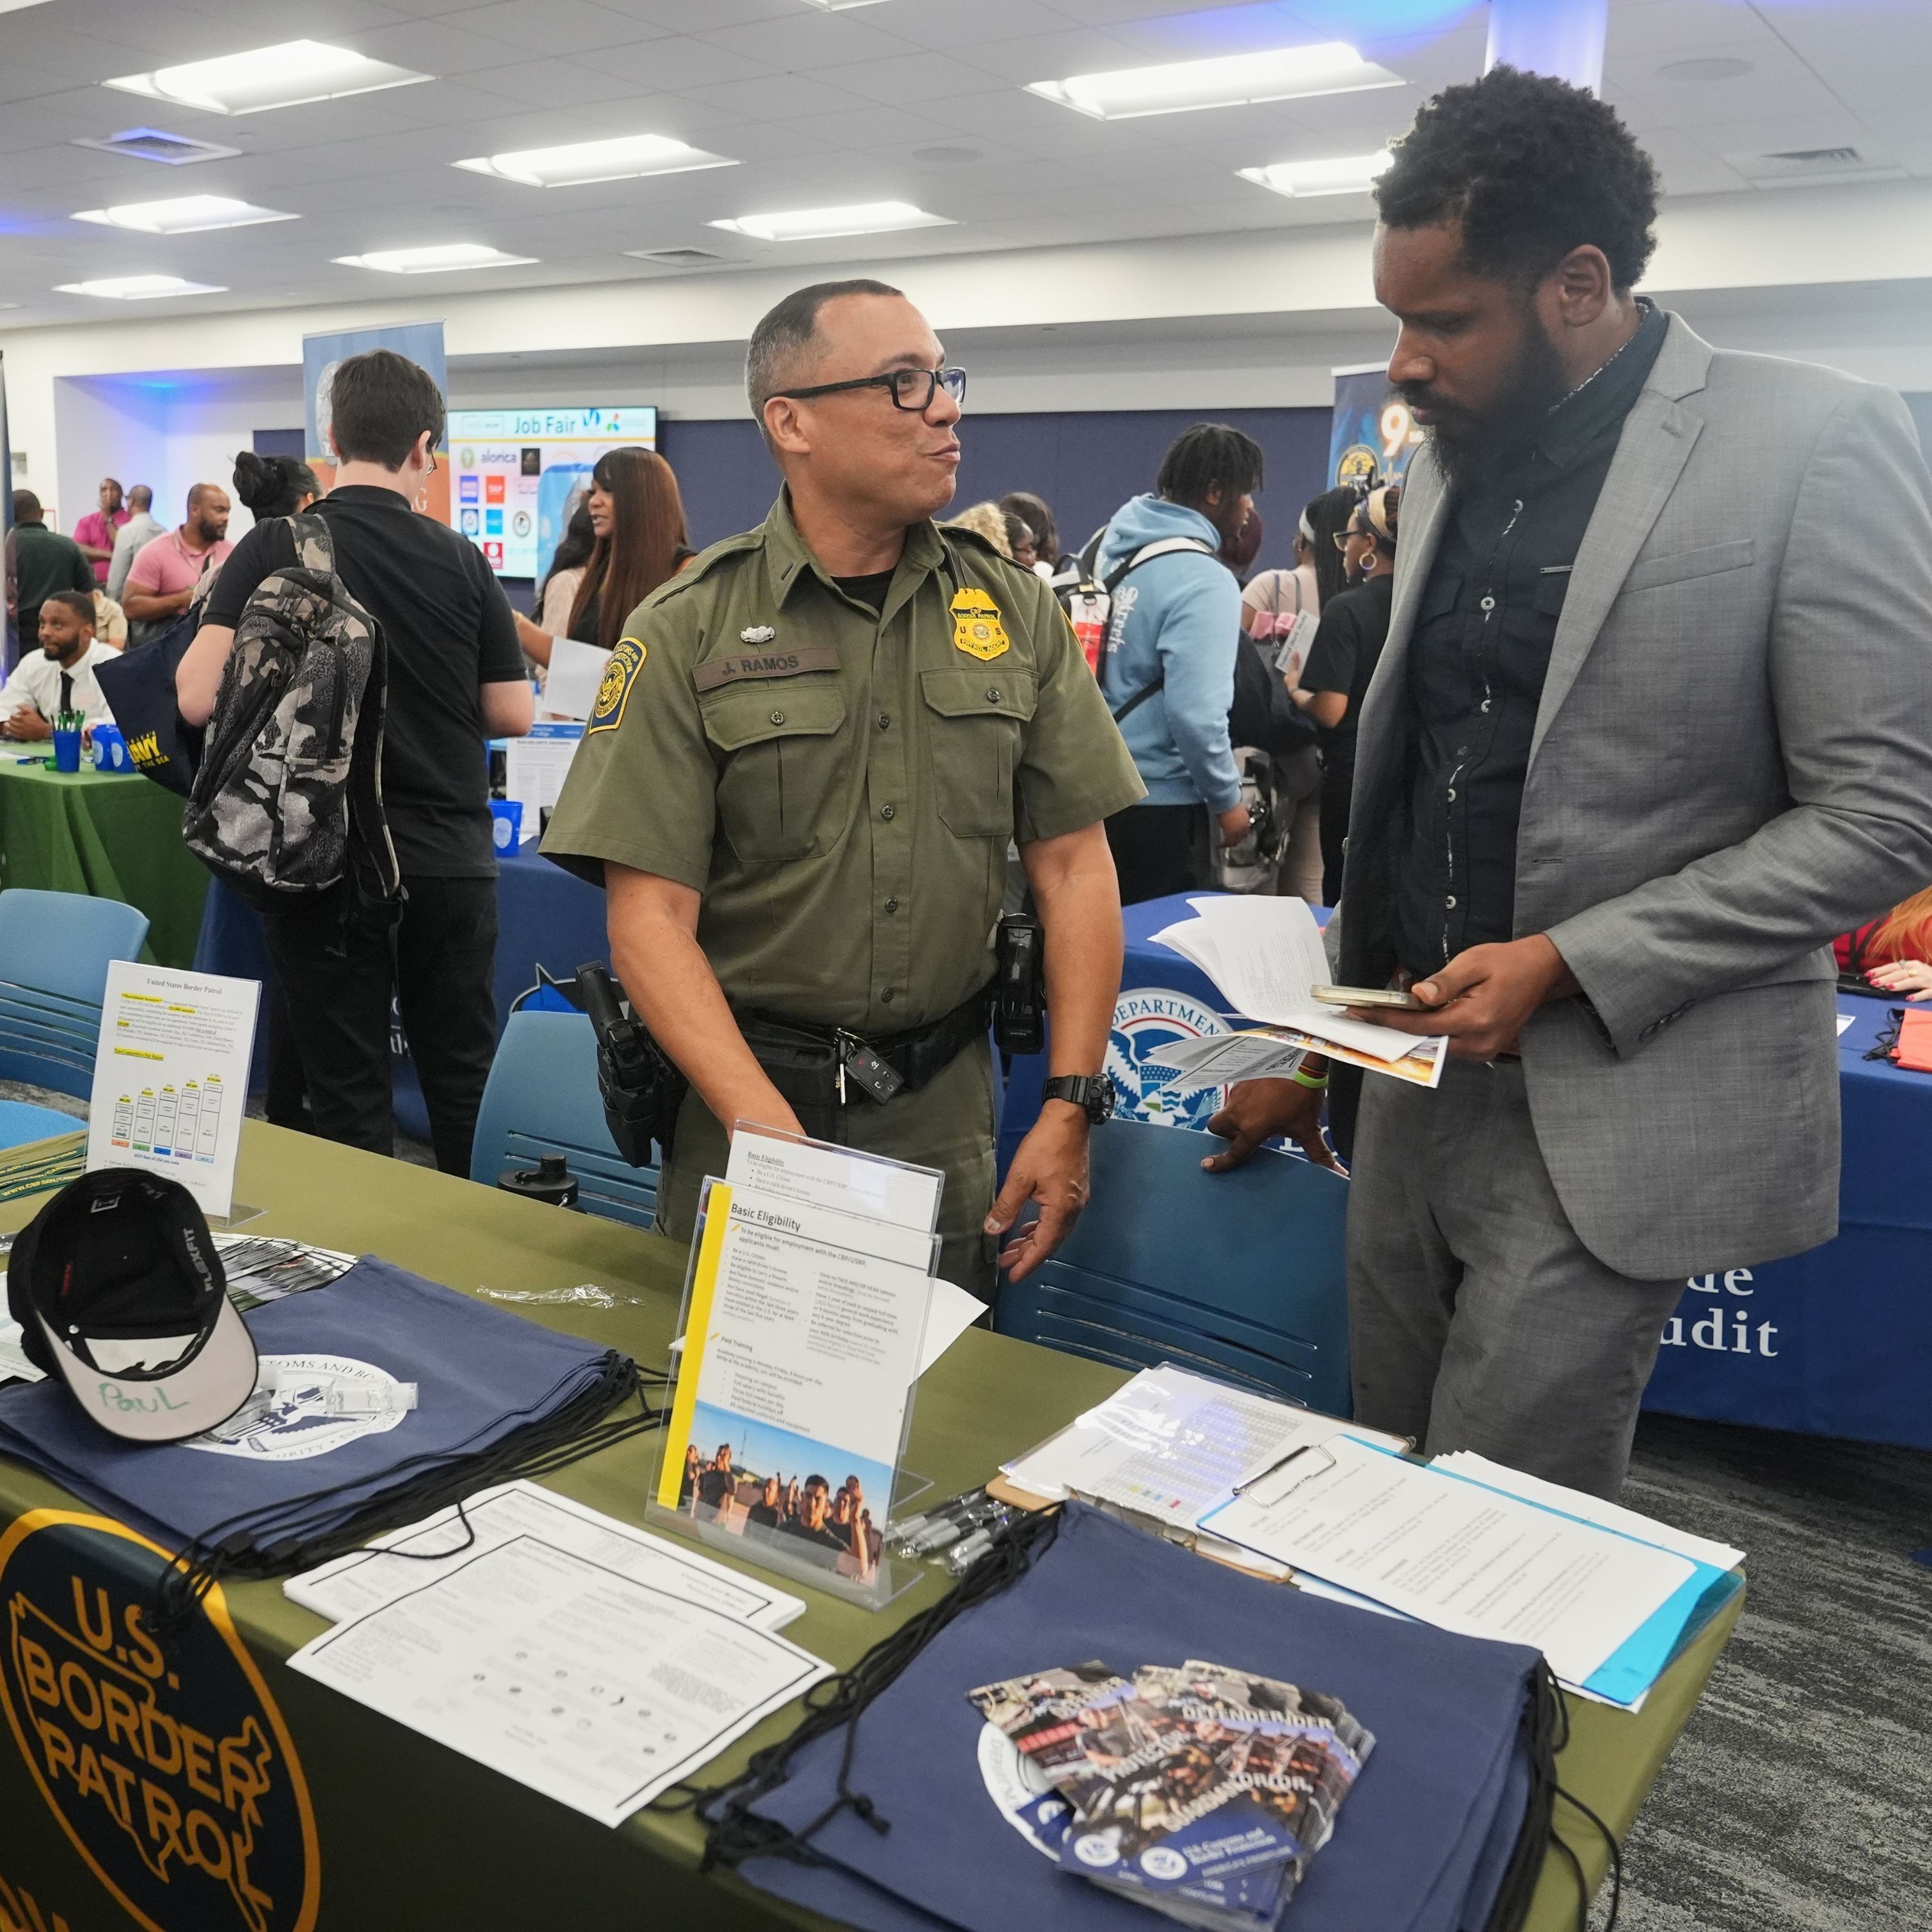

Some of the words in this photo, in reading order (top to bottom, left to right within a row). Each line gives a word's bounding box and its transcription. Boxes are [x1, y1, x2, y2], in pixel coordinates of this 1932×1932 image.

[515, 417, 541, 433] Job
[547, 416, 576, 433] Fair
[961, 638, 986, 652] PATROL
[987, 639, 1004, 652] AGENT
[722, 661, 736, 676] J.
[741, 655, 799, 672] RAMOS
[146, 978, 165, 987] United
[165, 980, 182, 989] States
[183, 982, 204, 991] Border
[204, 985, 222, 994] Patrol
[1112, 999, 1220, 1036] DEPARTMEN
[747, 1150, 761, 1160] Basic
[761, 1154, 784, 1166] Eligibility
[730, 1202, 755, 1218] Basic
[756, 1209, 801, 1233] Eligibility
[738, 1235, 764, 1248] applicants
[753, 1230, 772, 1242] eligible
[781, 1238, 815, 1253] employment
[815, 1247, 828, 1256] with
[827, 1250, 837, 1258] the
[721, 1336, 732, 1345] Paid
[1660, 1307, 1778, 1357] udit
[321, 1362, 354, 1376] AND
[72, 1575, 180, 1691] U.S.
[19, 1636, 263, 1828] BORDER
[37, 1716, 274, 1912] PATROL
